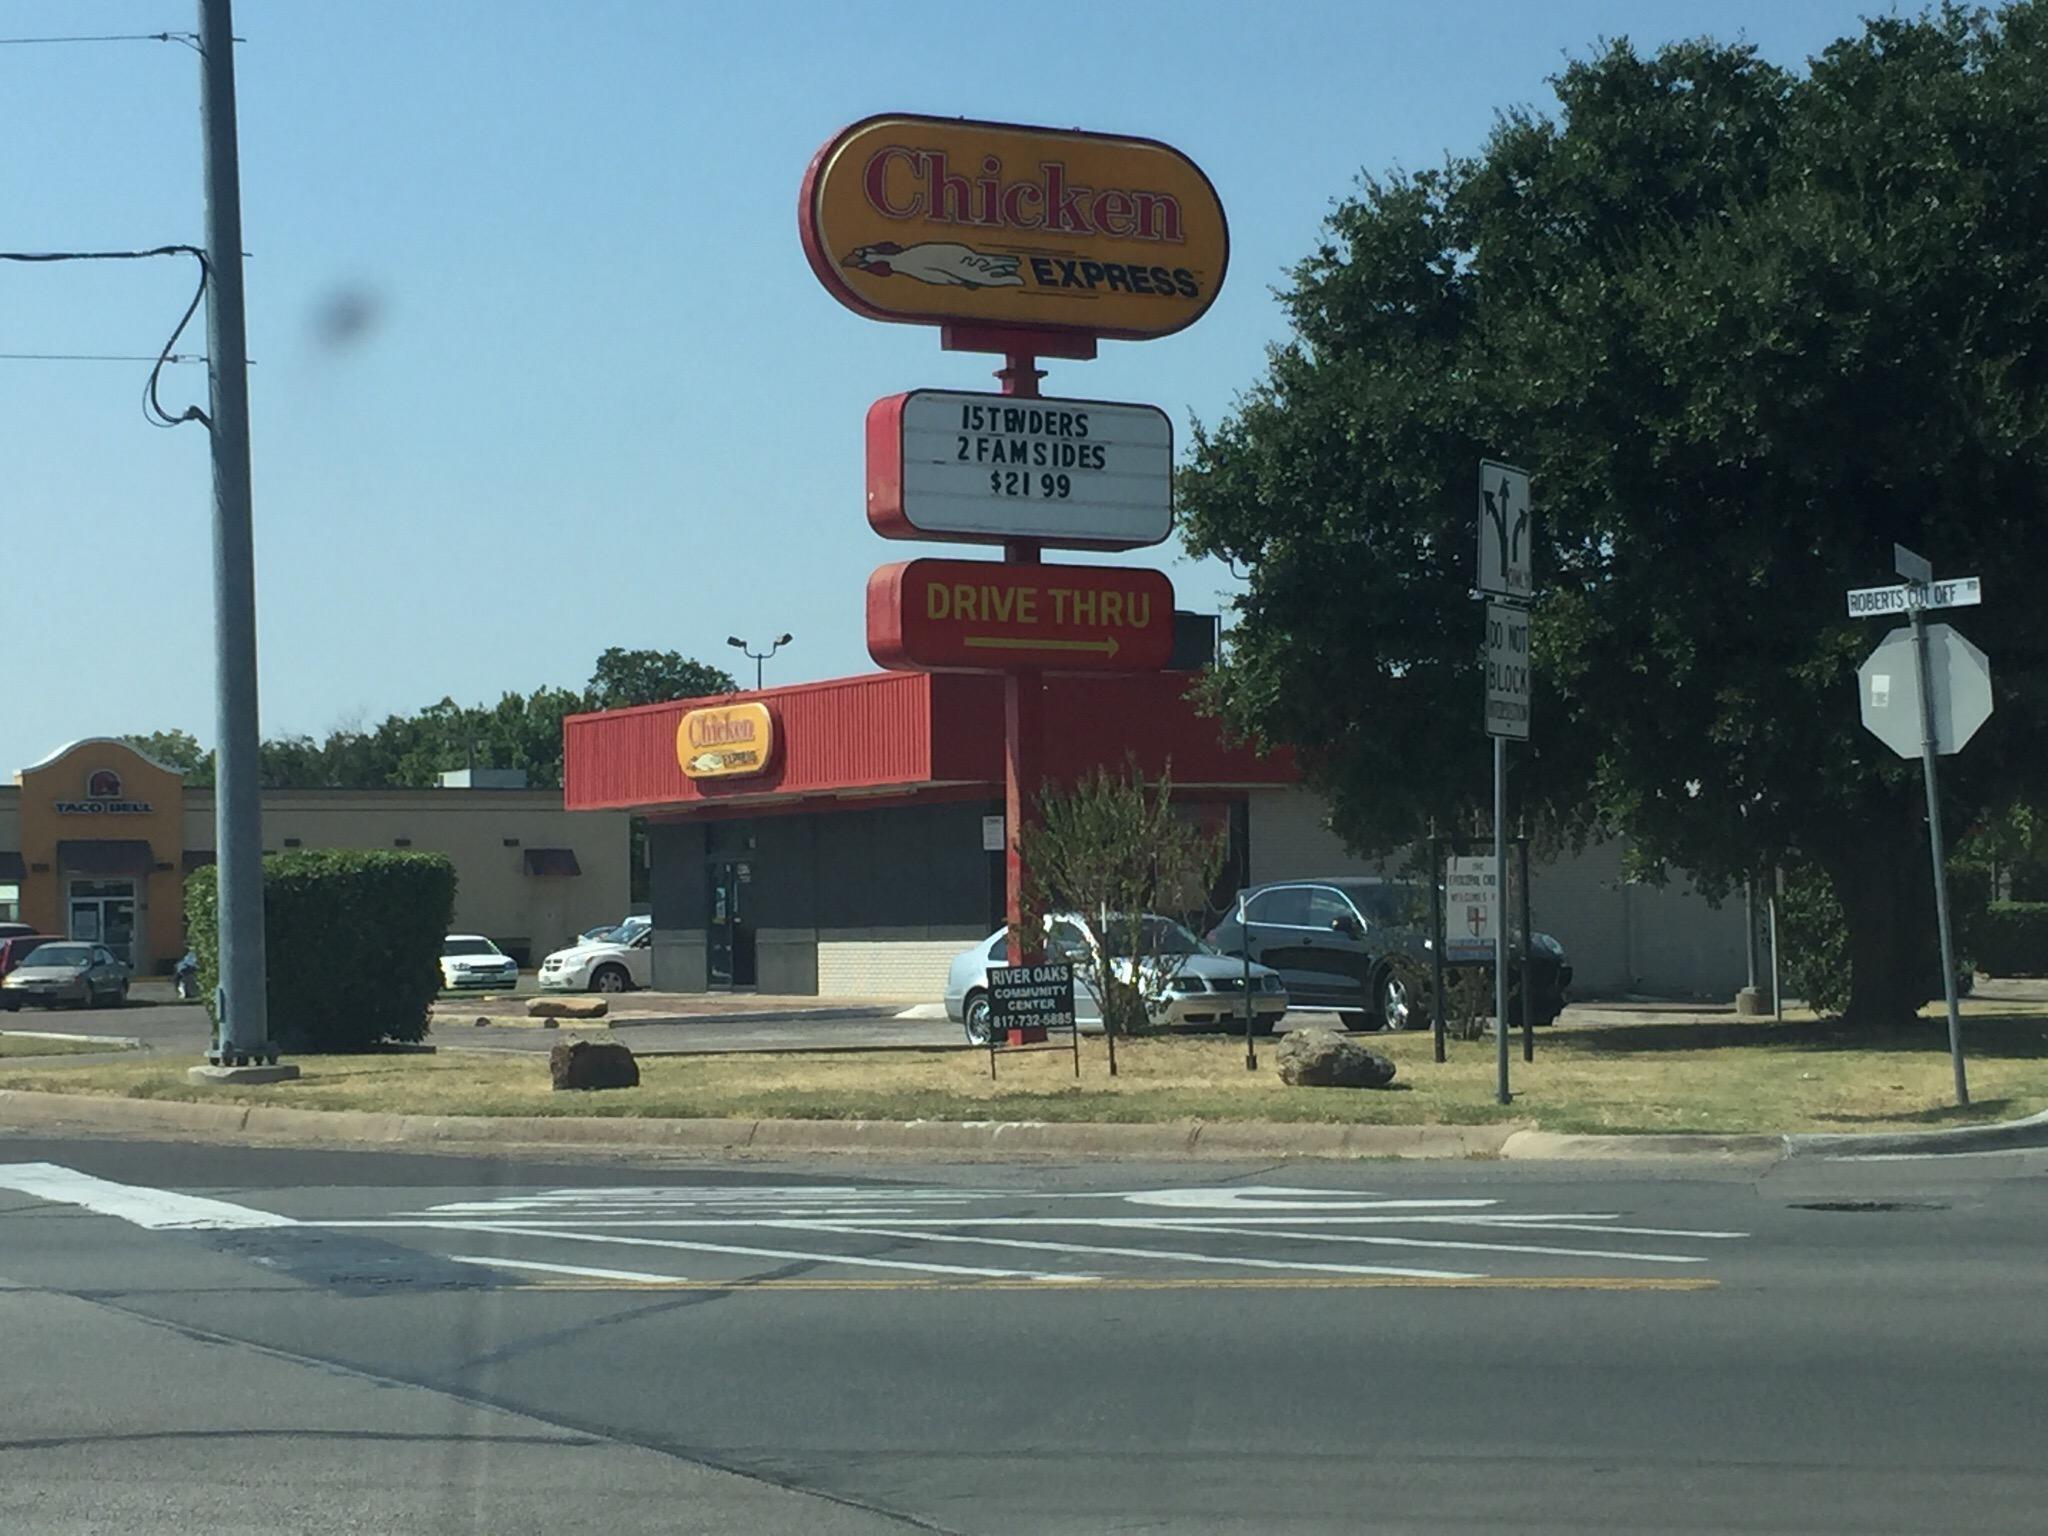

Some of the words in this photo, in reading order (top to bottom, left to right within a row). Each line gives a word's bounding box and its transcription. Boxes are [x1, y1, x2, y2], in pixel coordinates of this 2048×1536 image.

[863, 145, 1185, 243] Chicken
[1029, 257, 1199, 298] EXPRESS
[1033, 441, 1106, 470] SIDES
[927, 583, 1038, 624] DRIVE
[1047, 589, 1150, 628] THRU
[1850, 588, 1904, 612] ROBERTS
[1935, 583, 1957, 604] OFF
[1490, 621, 1502, 650] DO
[1509, 625, 1527, 654] NOT
[1489, 661, 1528, 694] BLOCK
[56, 802, 103, 813] TACO
[110, 802, 153, 813] BELL
[992, 968, 1031, 985] RIVER
[1033, 965, 1068, 982] OAKS
[994, 986, 1068, 999] COMMUNITY
[1007, 999, 1056, 1011] CENTER
